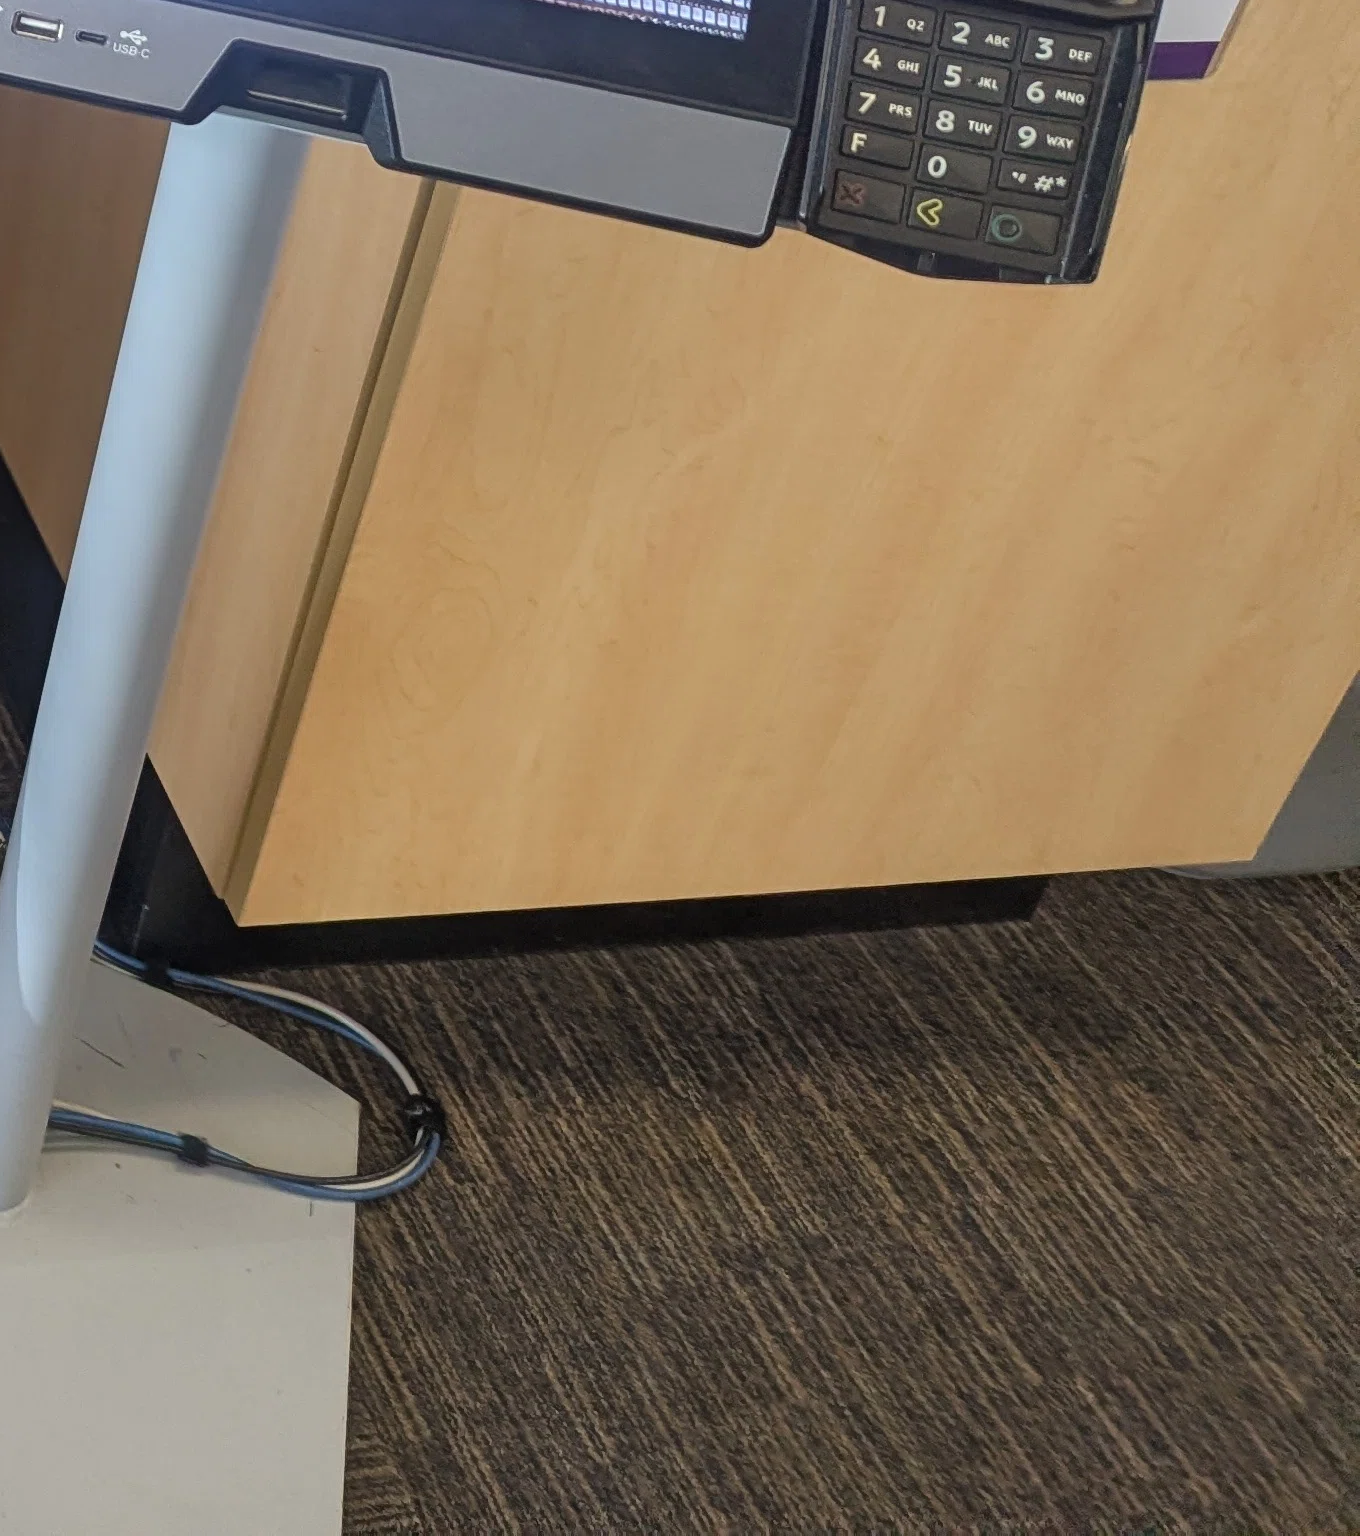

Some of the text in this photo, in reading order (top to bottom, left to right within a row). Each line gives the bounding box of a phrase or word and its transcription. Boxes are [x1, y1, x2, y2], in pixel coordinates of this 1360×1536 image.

[874, 5, 887, 27] 1
[951, 21, 971, 45] 2
[112, 42, 151, 59] USB-C
[862, 47, 882, 71] 4
[1034, 37, 1055, 61] 3
[943, 64, 964, 88] 5
[858, 91, 877, 115] 7
[1026, 81, 1046, 105] 6
[935, 110, 956, 133] 8
[1018, 126, 1038, 149] 9
